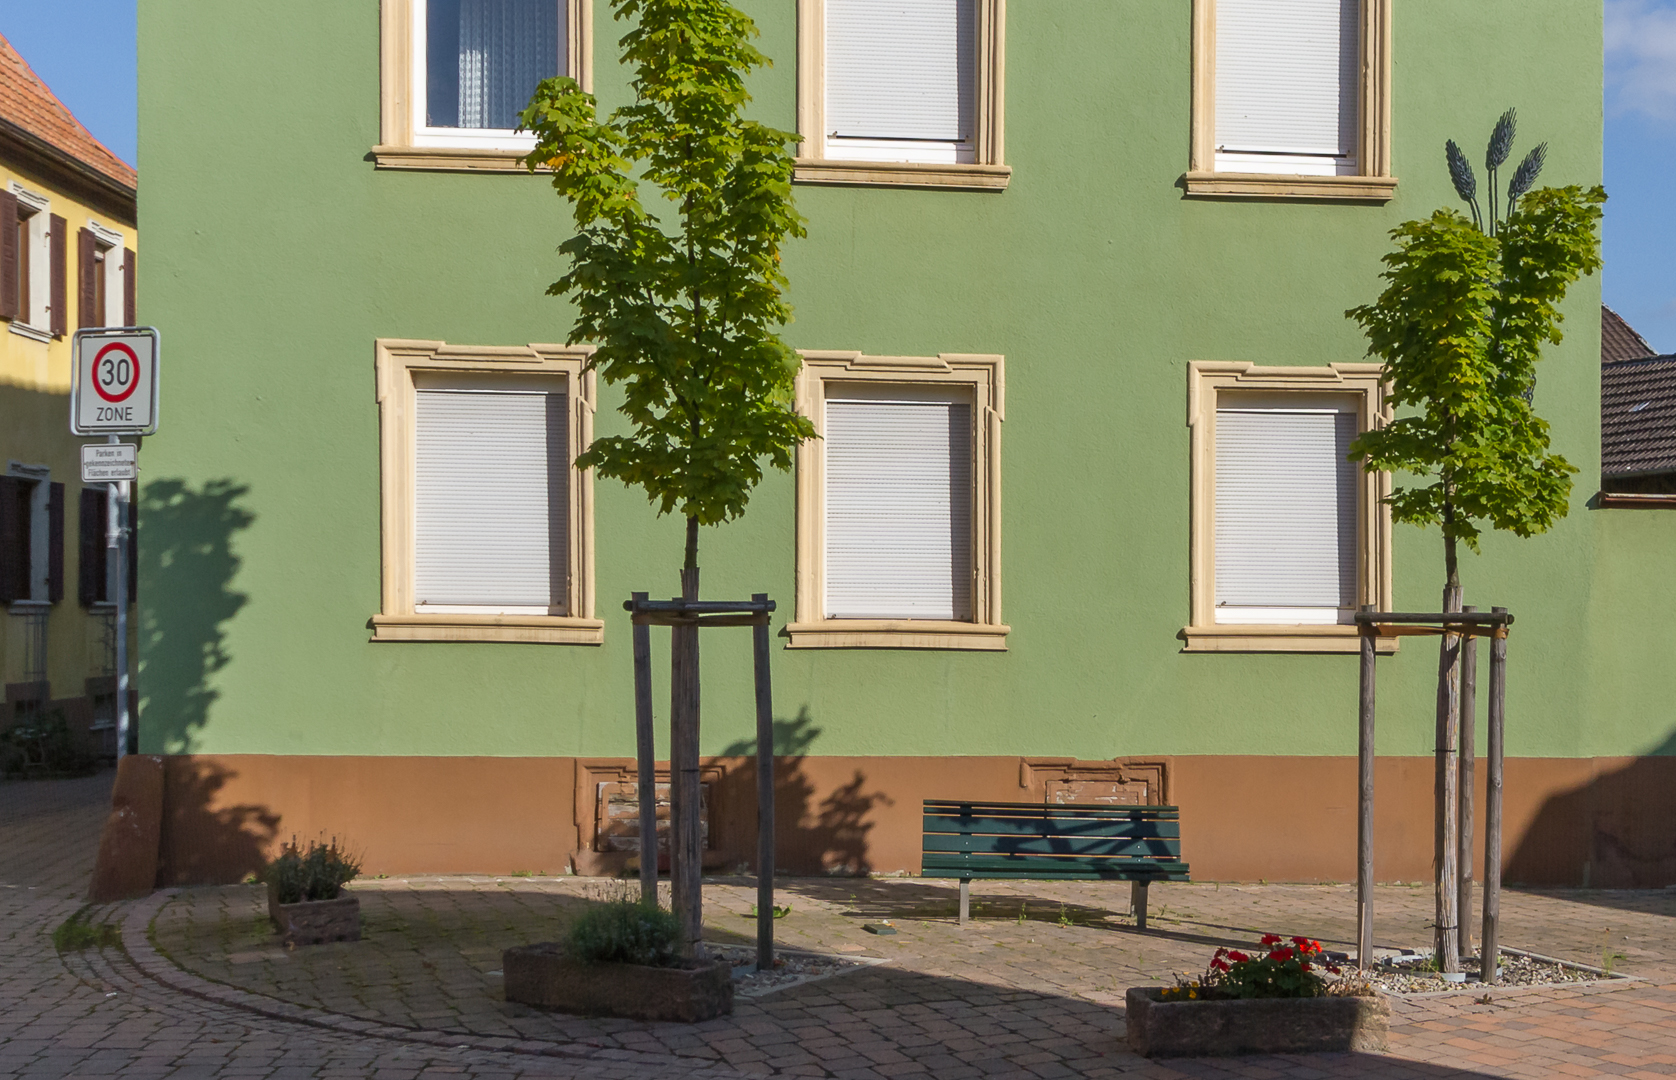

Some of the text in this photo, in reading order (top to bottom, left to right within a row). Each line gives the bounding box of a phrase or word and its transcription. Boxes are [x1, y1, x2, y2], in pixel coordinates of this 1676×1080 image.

[101, 358, 130, 386] 30
[96, 406, 133, 421] ZONE
[95, 449, 122, 457] Parken in
[88, 468, 131, 476] Flächen erlaubt
